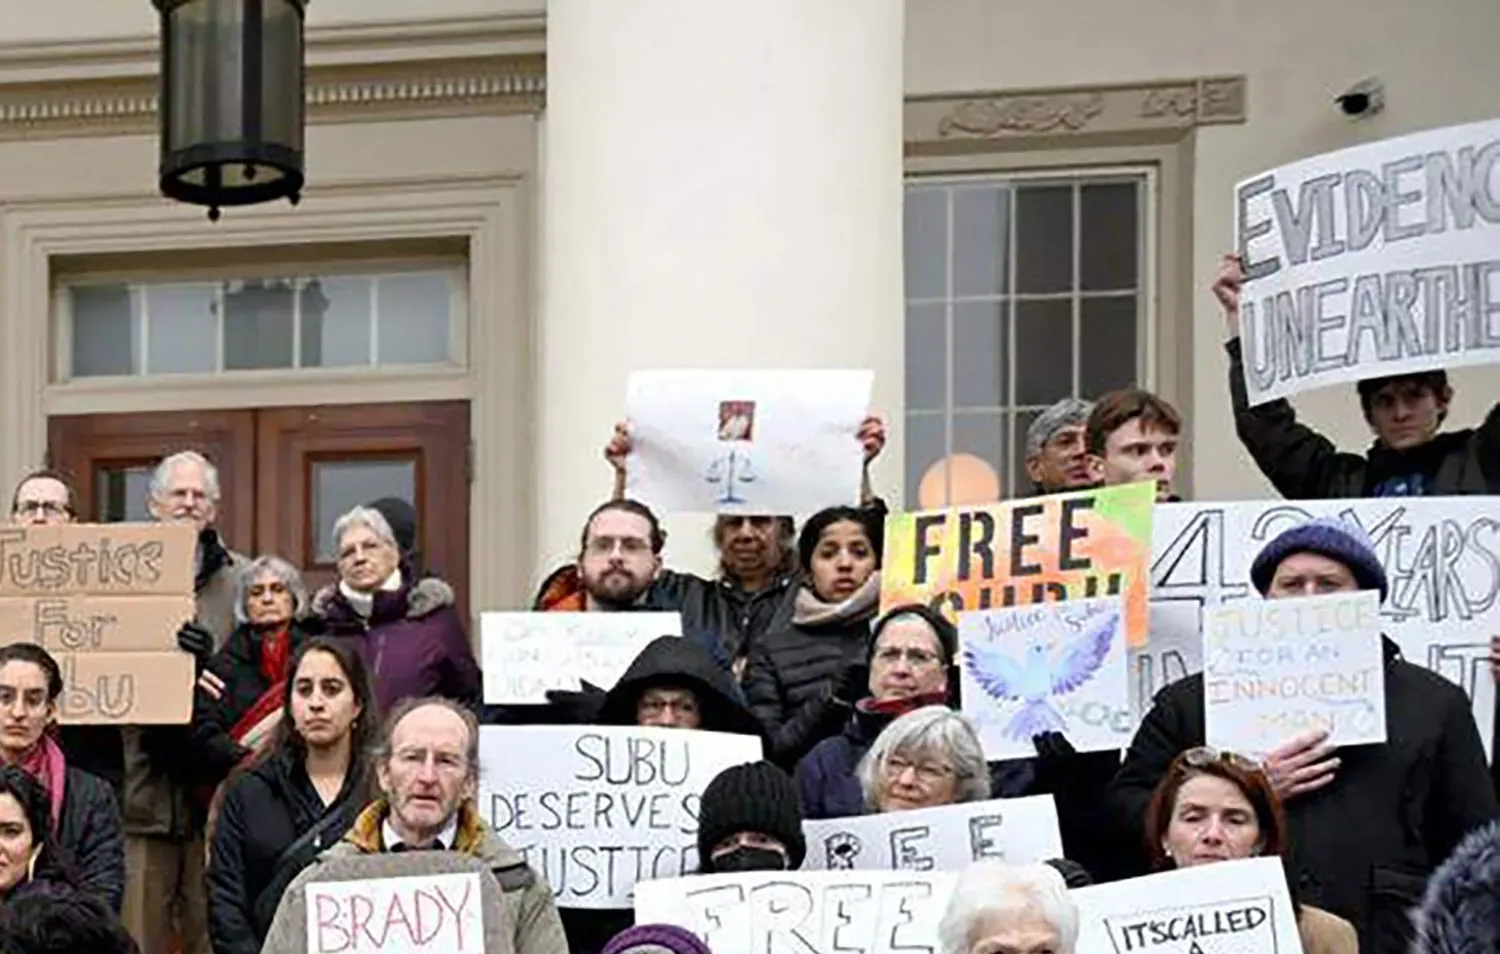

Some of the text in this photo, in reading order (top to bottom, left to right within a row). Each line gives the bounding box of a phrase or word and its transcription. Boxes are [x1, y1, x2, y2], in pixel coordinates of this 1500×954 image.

[913, 496, 1096, 586] FREE
[34, 599, 118, 650] For
[574, 733, 690, 787] SUBU
[490, 791, 700, 834] DESERVES
[824, 813, 1003, 871] REE
[315, 879, 472, 954] BRADY
